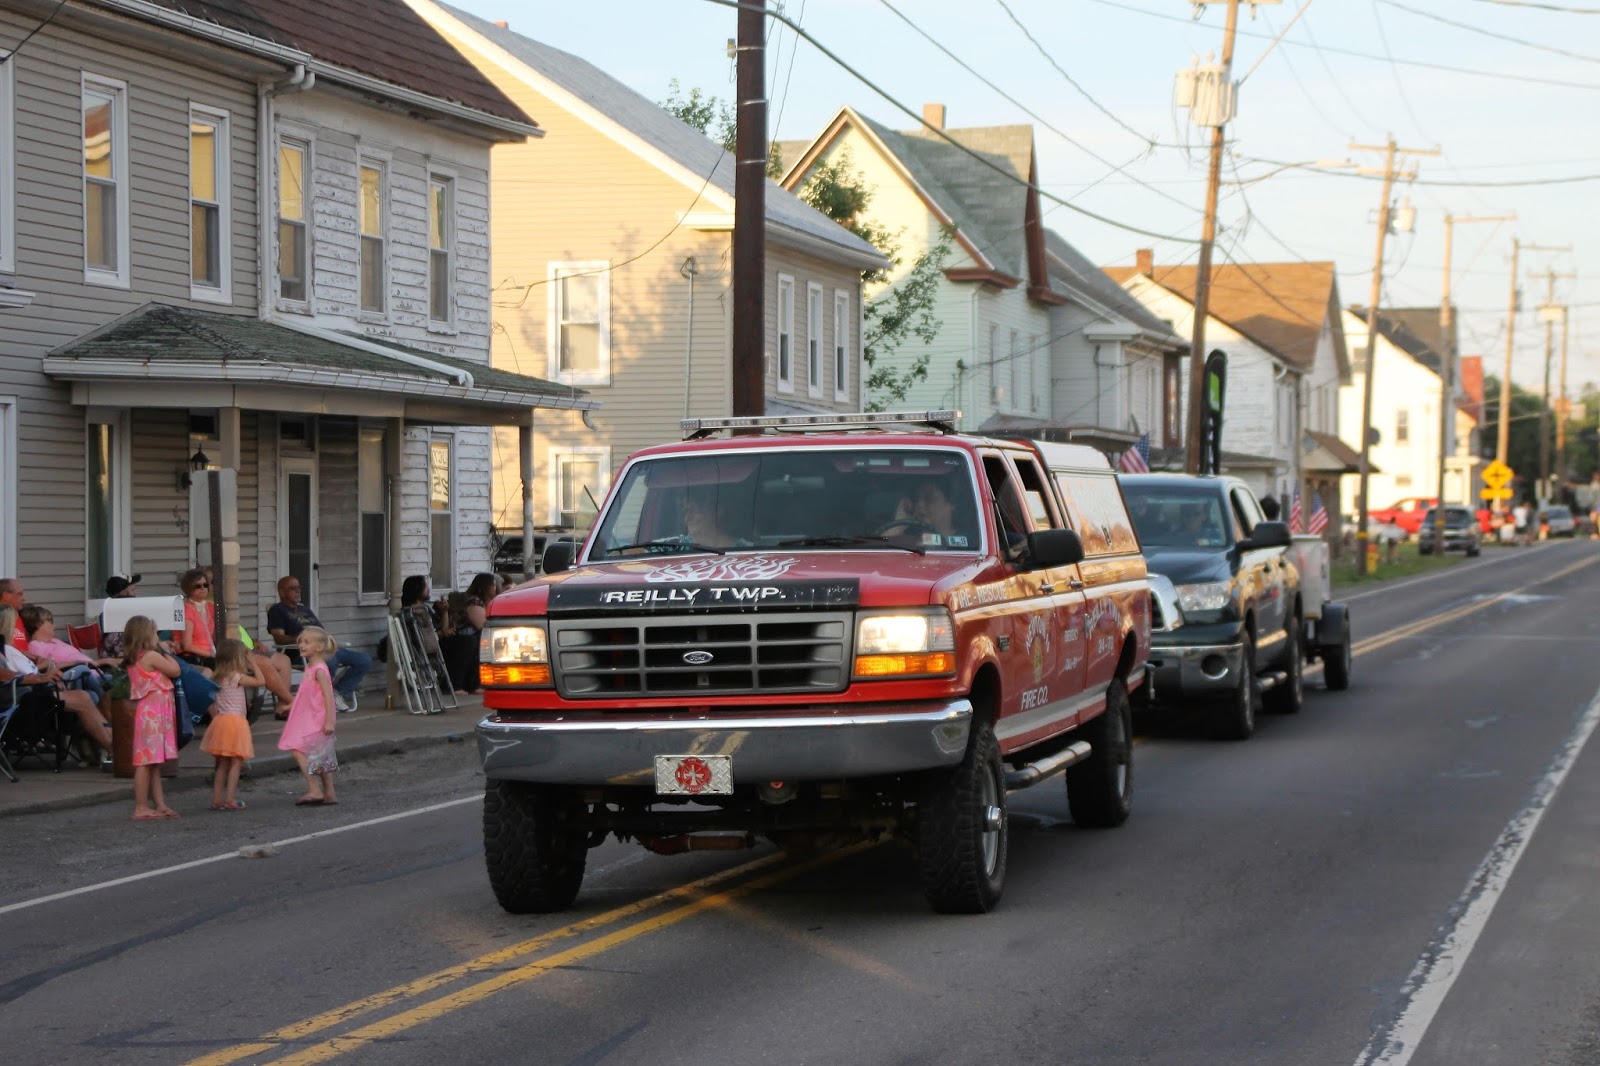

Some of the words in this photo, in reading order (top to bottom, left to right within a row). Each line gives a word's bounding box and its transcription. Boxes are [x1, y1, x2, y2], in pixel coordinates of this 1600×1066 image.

[606, 587, 701, 603] REILLY
[711, 586, 787, 600] TWP.
[952, 587, 973, 609] FIRE
[976, 580, 1008, 604] RESCUE
[1021, 690, 1037, 711] FIRE
[1037, 685, 1049, 706] CO.
